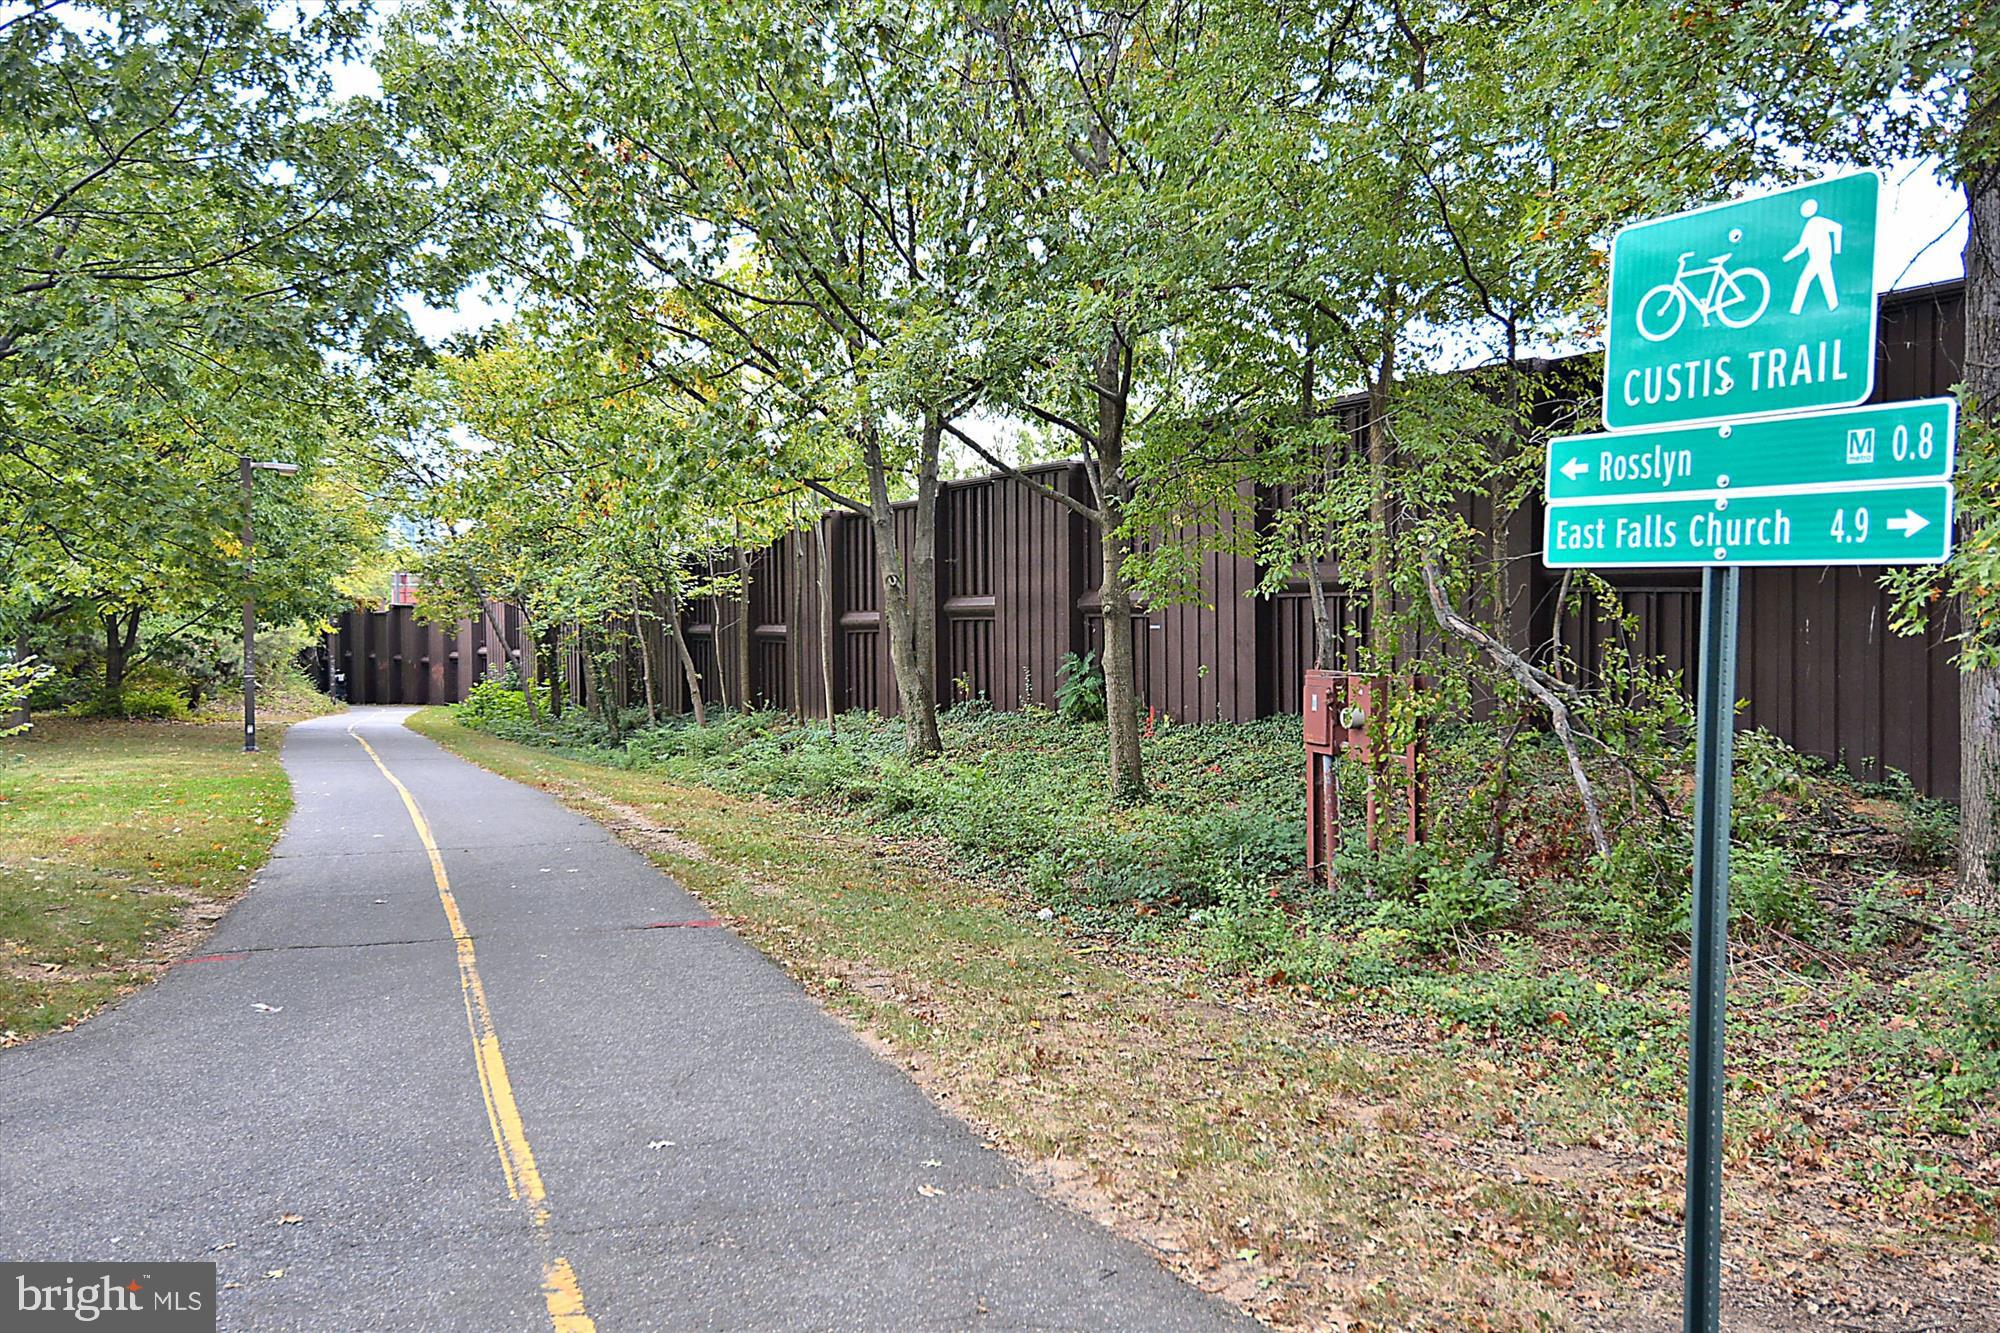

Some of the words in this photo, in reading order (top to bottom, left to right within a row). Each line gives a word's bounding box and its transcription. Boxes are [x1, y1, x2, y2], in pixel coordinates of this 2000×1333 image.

[1624, 355, 1733, 408] CUSTIS
[1748, 339, 1848, 391] TRAIL
[1599, 445, 1692, 487] Rosslyn
[1849, 431, 1872, 454] M
[1892, 422, 1934, 462] 0.8
[1556, 517, 1605, 550] East
[1615, 513, 1677, 548] Falls
[1689, 509, 1791, 547] Church
[1830, 506, 1870, 544] 4.9
